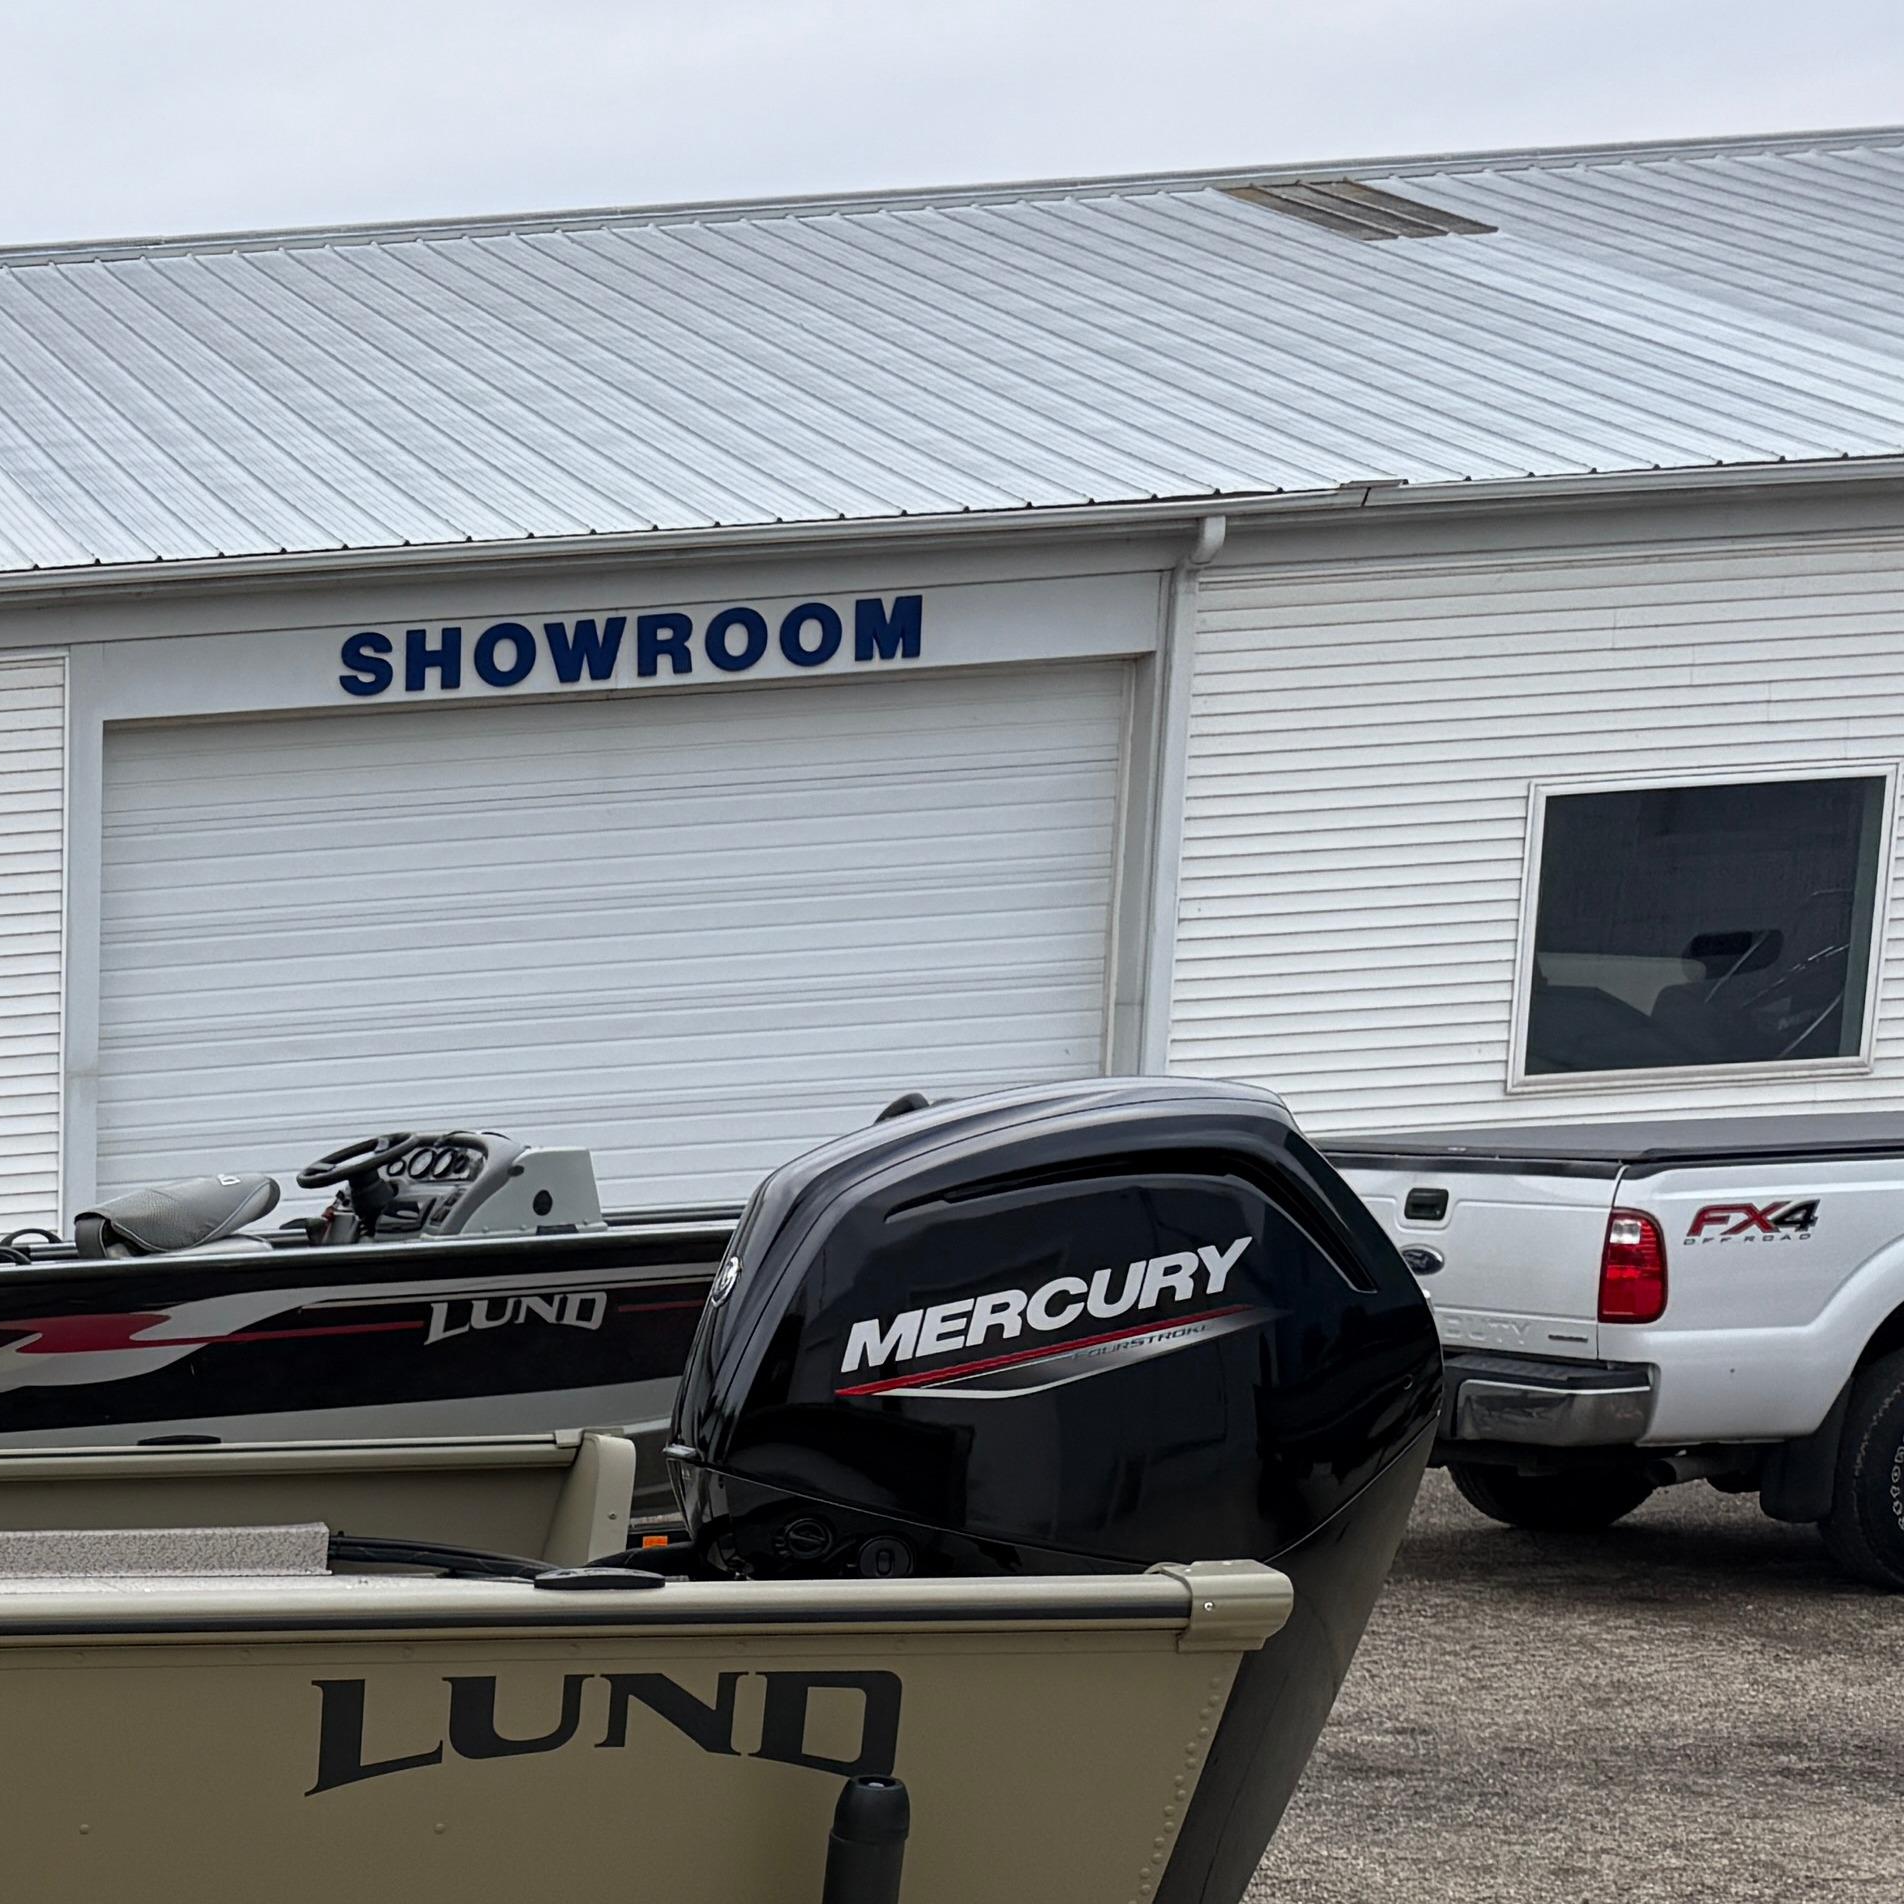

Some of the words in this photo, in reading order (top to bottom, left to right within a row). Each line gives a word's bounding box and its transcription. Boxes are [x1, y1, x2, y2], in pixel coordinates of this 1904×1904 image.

[337, 593, 926, 698] SHOWROOM
[1682, 1236, 1732, 1246] OFF
[1743, 1232, 1812, 1243] ROAD
[1685, 1198, 1821, 1238] FX4
[422, 1290, 608, 1347] LUND
[839, 1235, 1254, 1374] MERCURY
[304, 1669, 904, 1798] LUND
